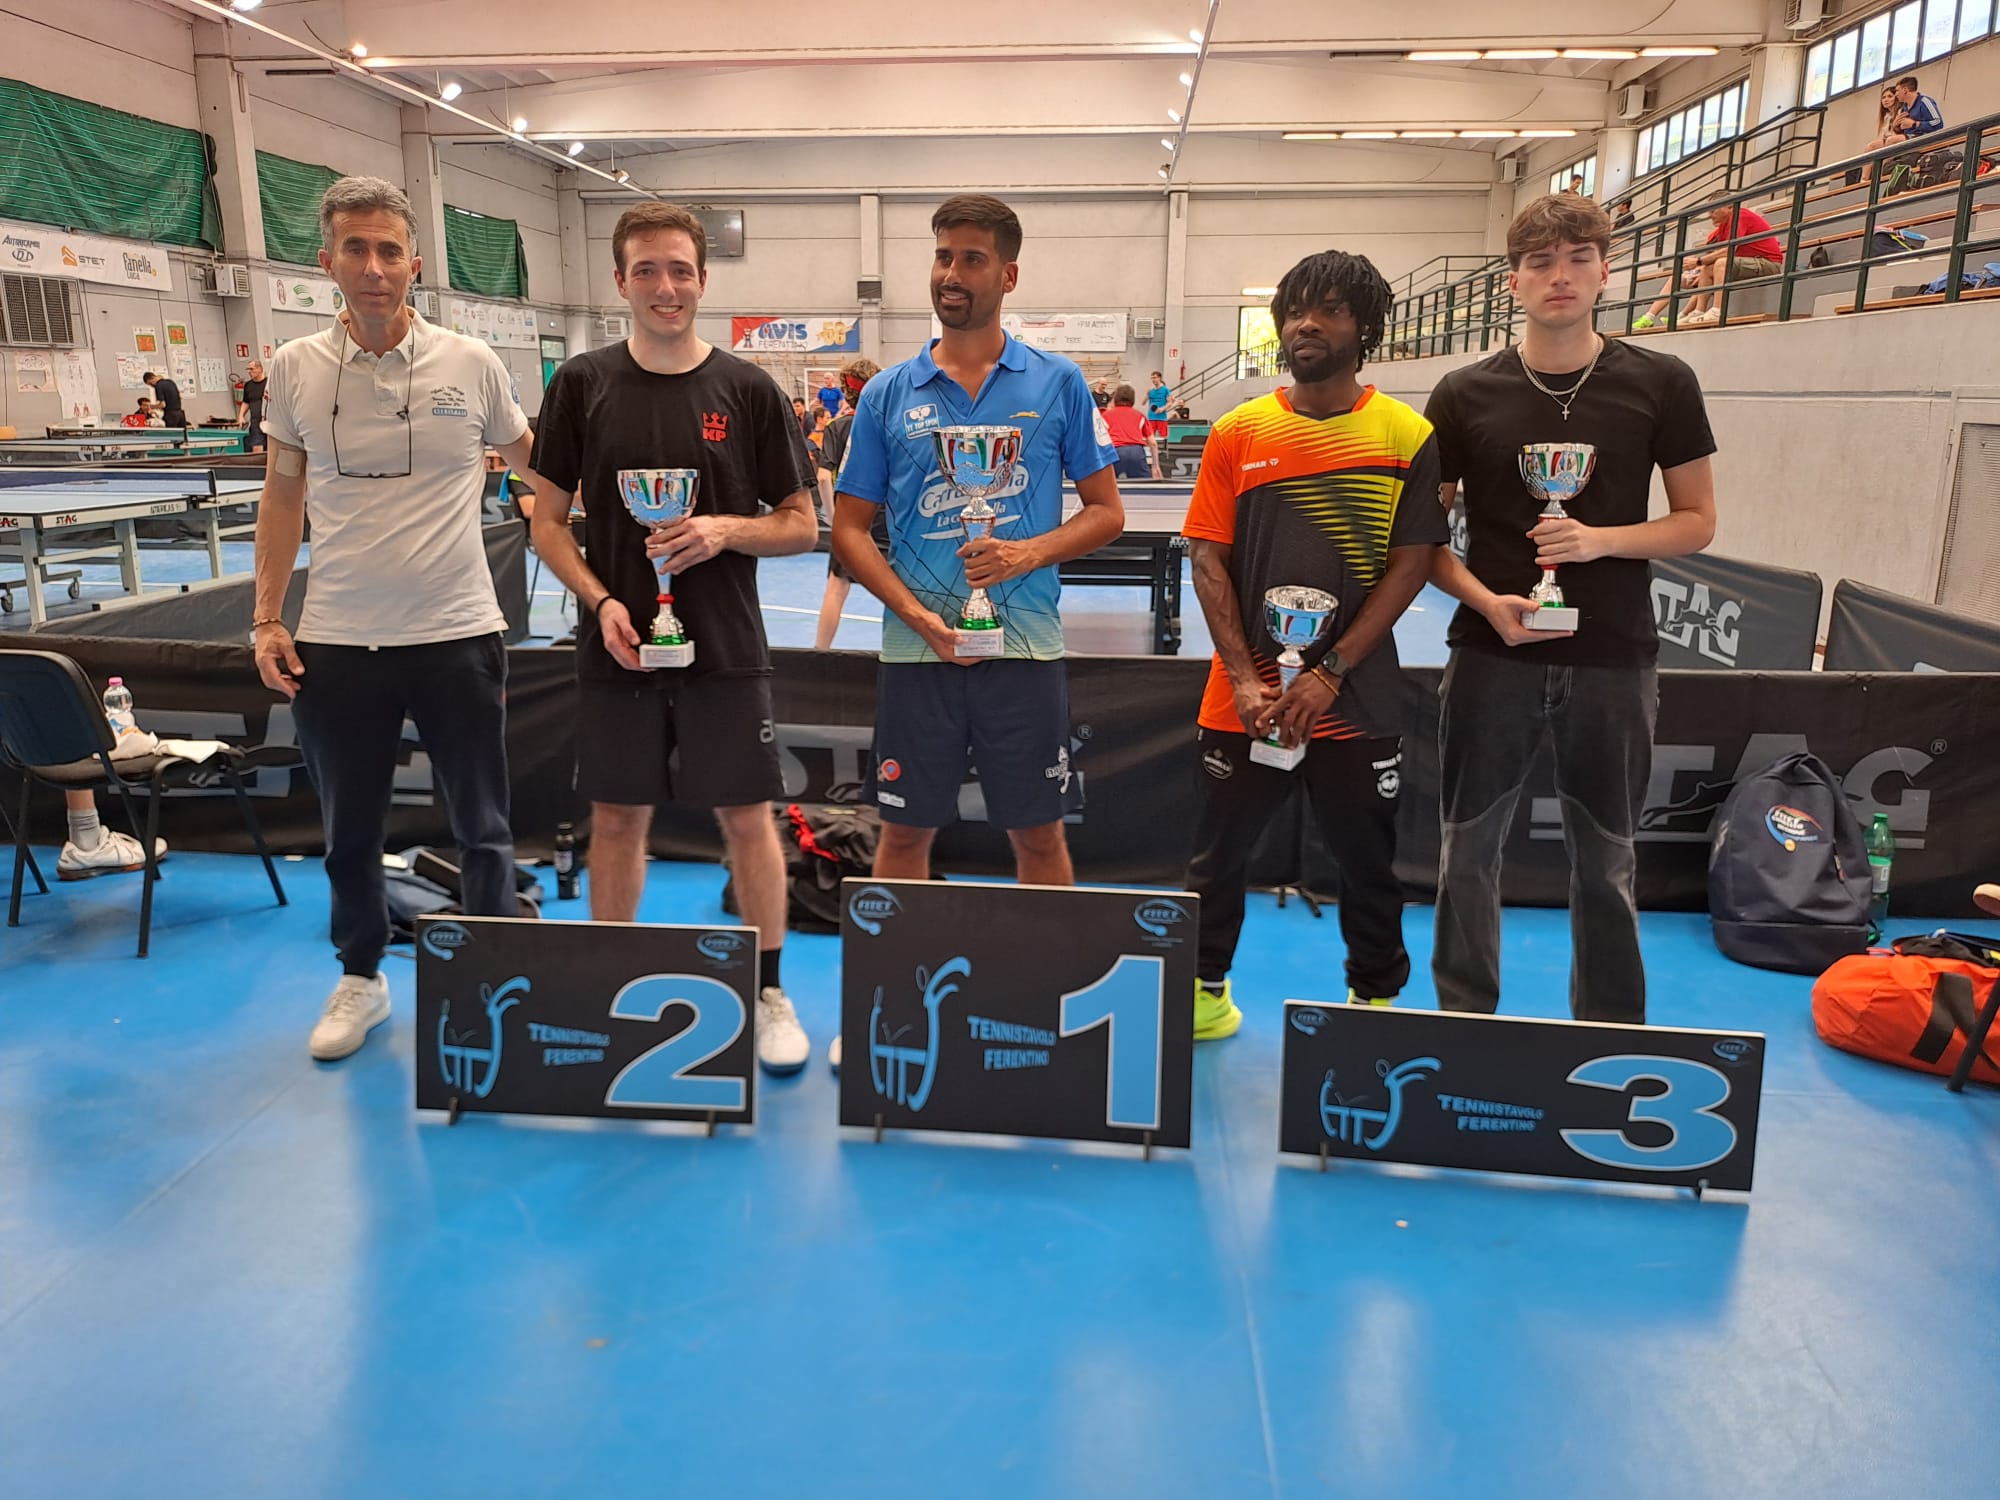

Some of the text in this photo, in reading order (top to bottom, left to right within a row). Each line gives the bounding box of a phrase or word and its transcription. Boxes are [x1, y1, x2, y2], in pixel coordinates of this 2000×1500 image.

[78, 255, 105, 266] STET
[758, 323, 807, 340] AVIS
[703, 428, 727, 442] KP
[56, 515, 77, 525] STAG
[527, 1022, 612, 1048] TENNISTAVOLO
[605, 973, 747, 1111] 2
[967, 1015, 1056, 1046] TENNISTAVOLO
[1059, 954, 1165, 1130] 1
[543, 1048, 605, 1067] FERENTINO
[984, 1048, 1050, 1071] FERENTINO
[1437, 1094, 1545, 1121] TENNISTAVOLO
[1558, 1054, 1738, 1172] 3
[1457, 1116, 1537, 1132] FERENTINO
